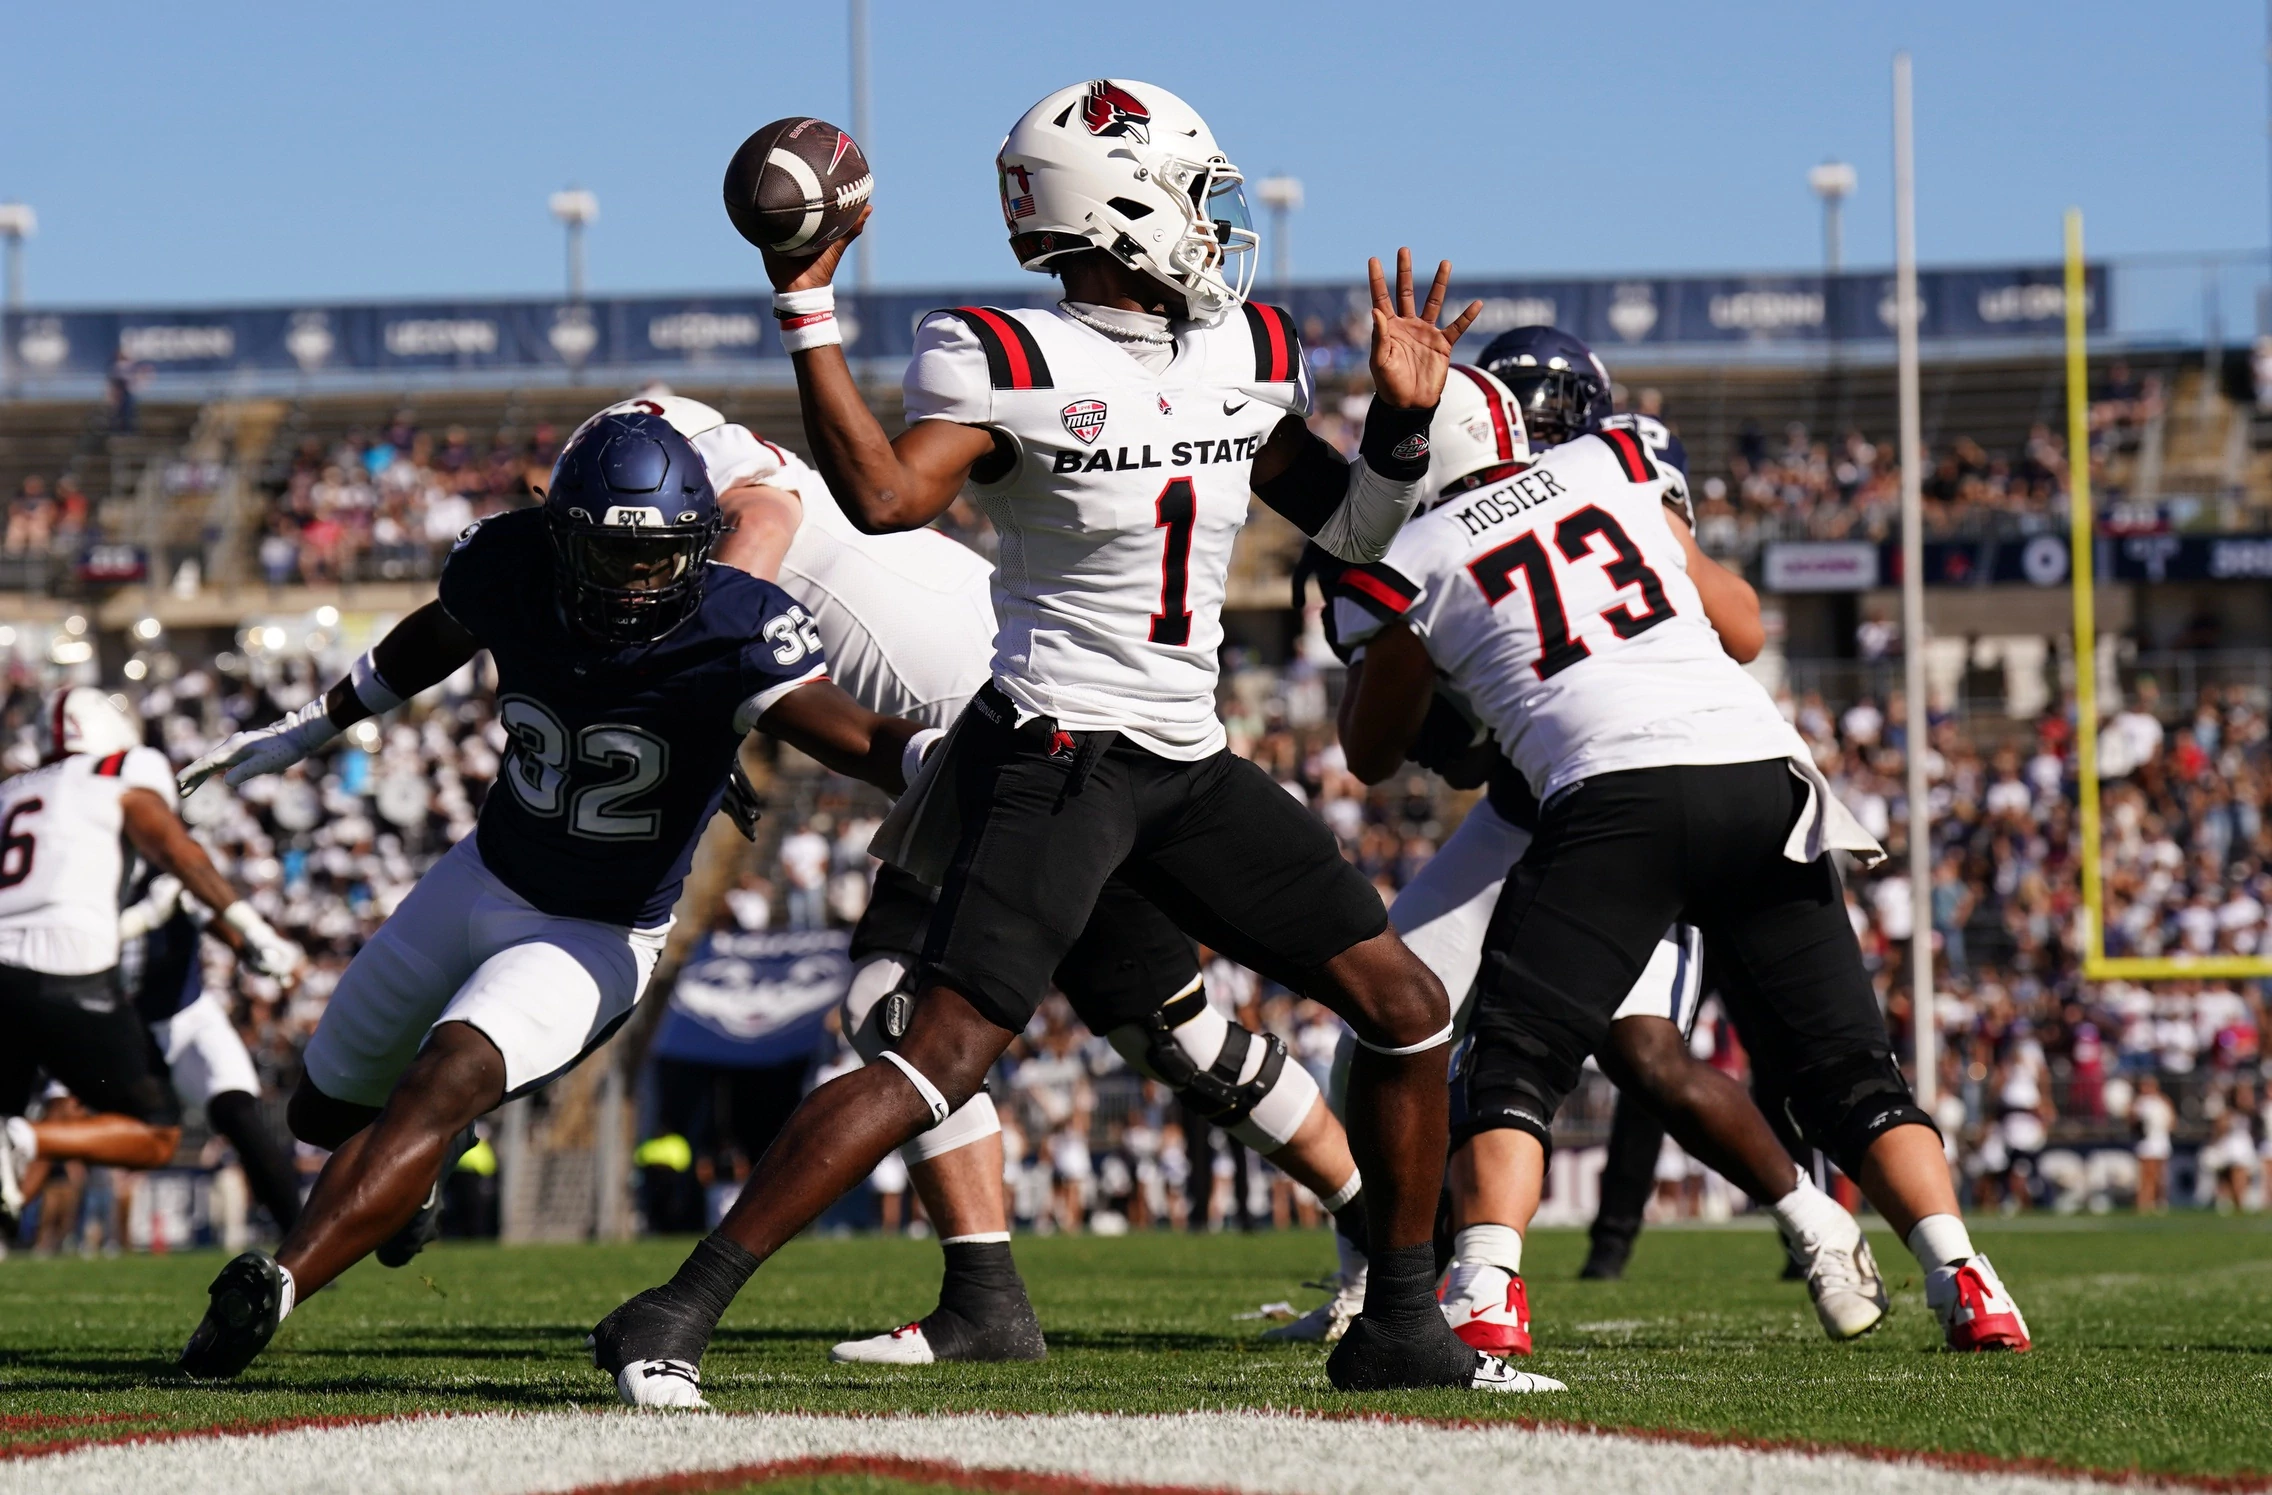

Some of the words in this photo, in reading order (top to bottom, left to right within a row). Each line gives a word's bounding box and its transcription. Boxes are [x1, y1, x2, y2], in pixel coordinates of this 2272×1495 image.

[1052, 444, 1162, 473] BALL
[1171, 435, 1258, 466] STATE
[1066, 411, 1106, 428] MAC
[1453, 470, 1567, 536] MOSIER
[1147, 476, 1197, 647] 1
[1465, 503, 1678, 682] 73
[762, 605, 824, 666] 32
[499, 693, 670, 842] 32
[0, 797, 43, 890] 6
